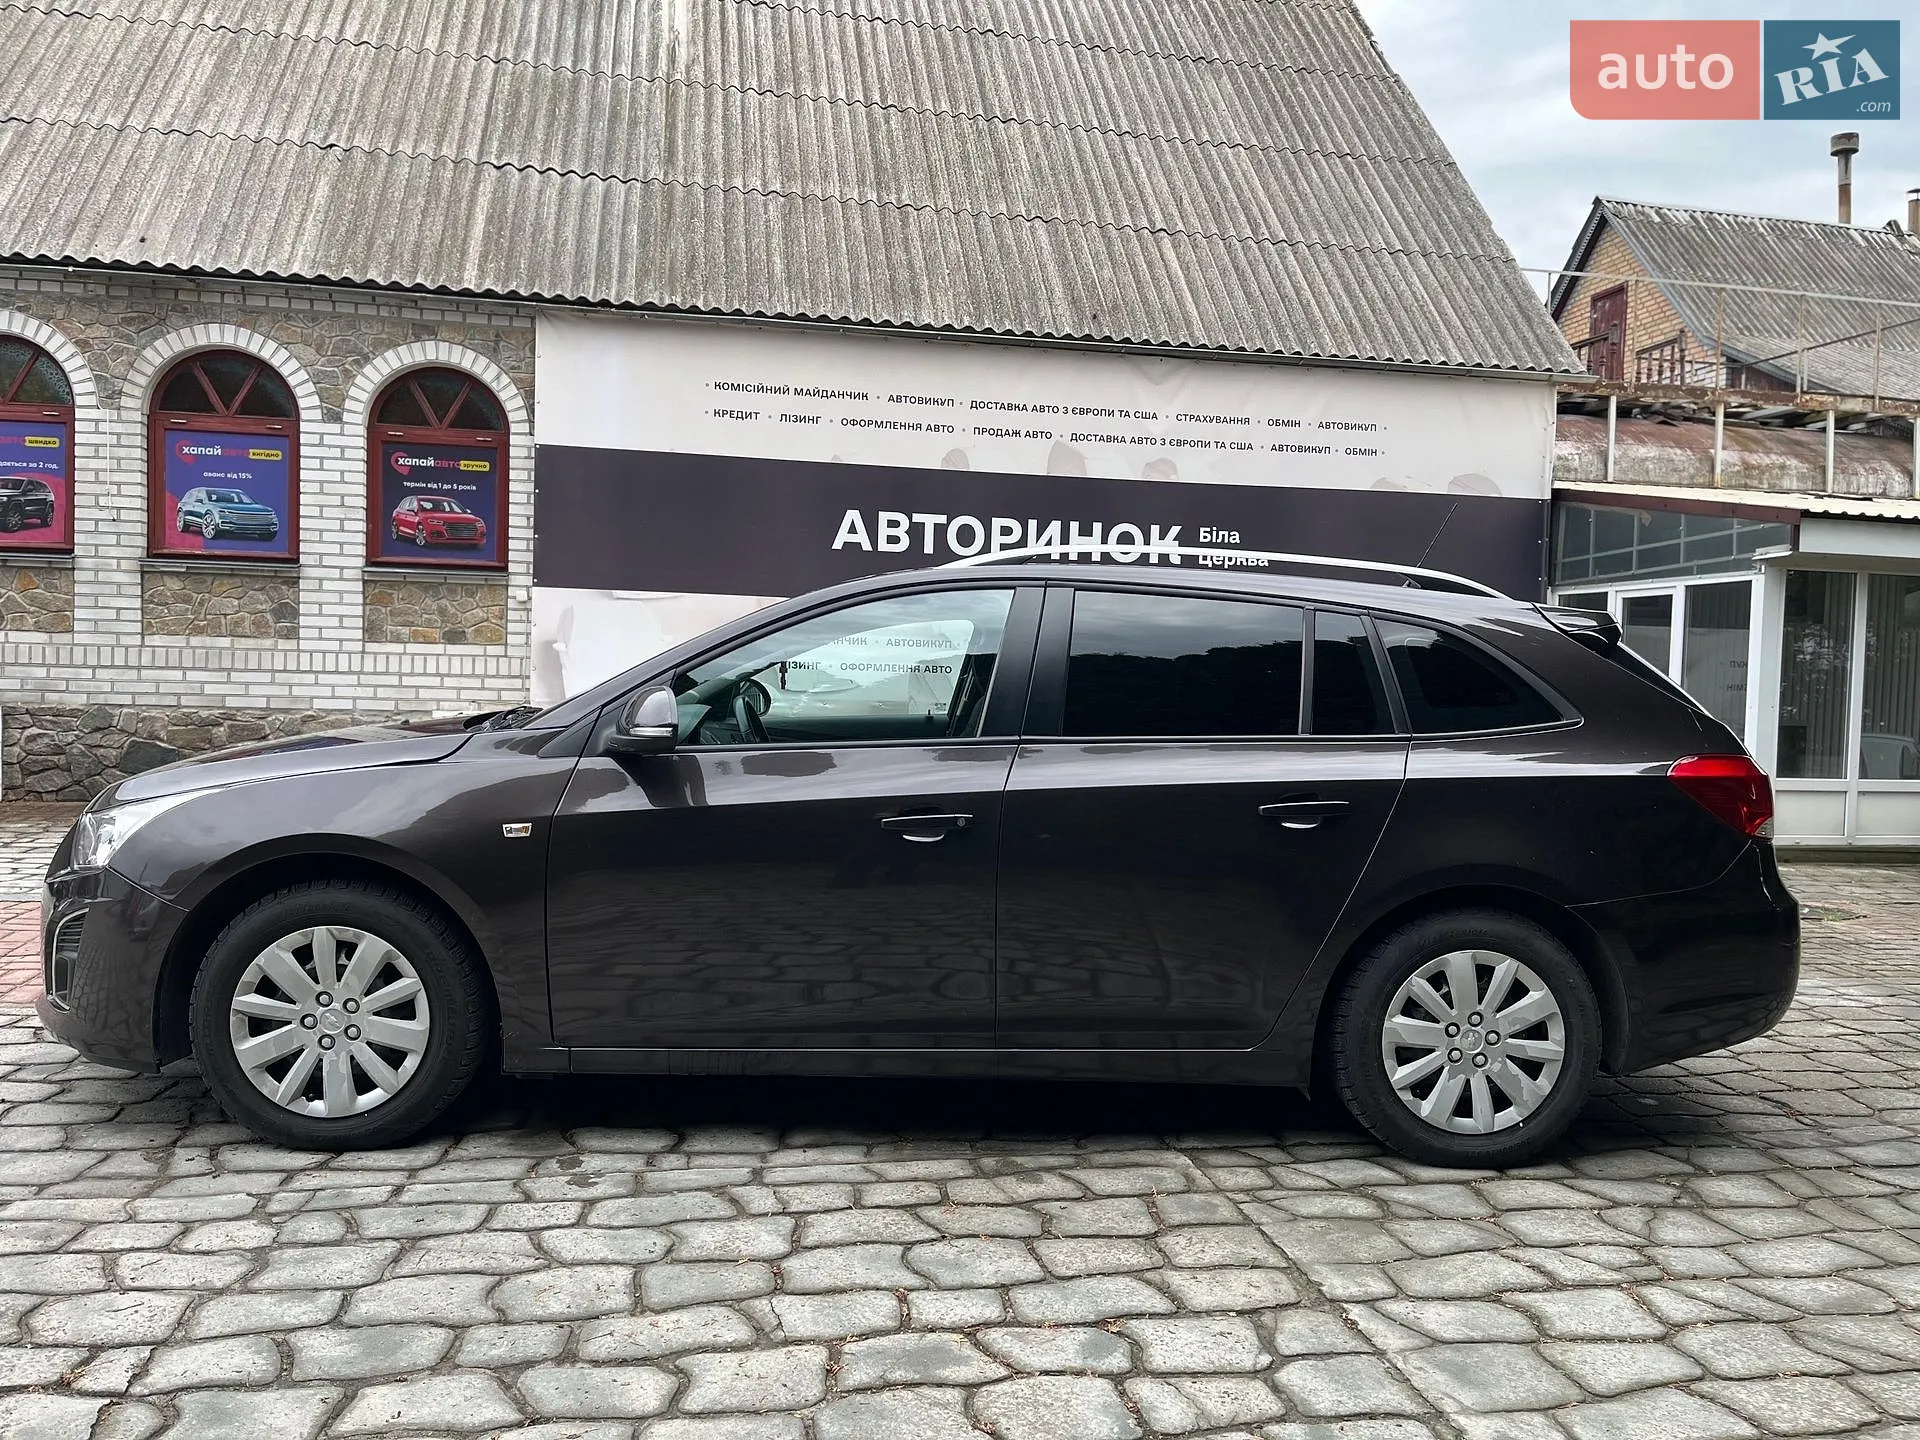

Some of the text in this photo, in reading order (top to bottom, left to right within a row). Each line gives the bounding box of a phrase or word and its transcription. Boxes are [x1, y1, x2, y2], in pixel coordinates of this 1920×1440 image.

[714, 381, 790, 396] КОМІСІЙНИЙ
[793, 386, 869, 401] МАЙДАНЧИК
[887, 394, 955, 408] АВТОВИКУП
[969, 400, 1029, 413] ДОСТАВКА
[1030, 403, 1060, 414] АВТО
[1071, 406, 1115, 418] ЄВРОПИ
[1117, 409, 1131, 419] ТА
[1133, 410, 1159, 421] США
[1175, 413, 1250, 426] СТРАХУВАННЯ
[1267, 418, 1301, 428] ОБМІН
[1317, 421, 1377, 432] АВТОВИКУП
[713, 408, 761, 421] КРЕДИТ
[779, 413, 822, 425] ЛІЗИНГ
[840, 417, 923, 432] ОФОРМЛЕННЯ
[925, 423, 955, 434] АВТО
[973, 426, 1022, 439] ПРОДАЖ
[1023, 430, 1053, 441] АВТО
[1069, 432, 1127, 445] ДОСТАВКА
[1129, 436, 1158, 446] АВТО
[1168, 438, 1211, 449] ЄВРОПИ
[1213, 440, 1227, 450] ТА
[1229, 441, 1254, 451] США
[1270, 443, 1331, 455] АВТОВИКУП
[1344, 447, 1378, 457] ОБМІН
[203, 471, 253, 480] аванс від 15%
[403, 481, 427, 489] термін
[831, 508, 1182, 565] АВТОРИНОК
[1199, 526, 1241, 544] Біла
[886, 637, 953, 649] АВТОВИКУП
[788, 660, 953, 674] ІЗИНГ ОФОРМЛЕННЯ АВТО
